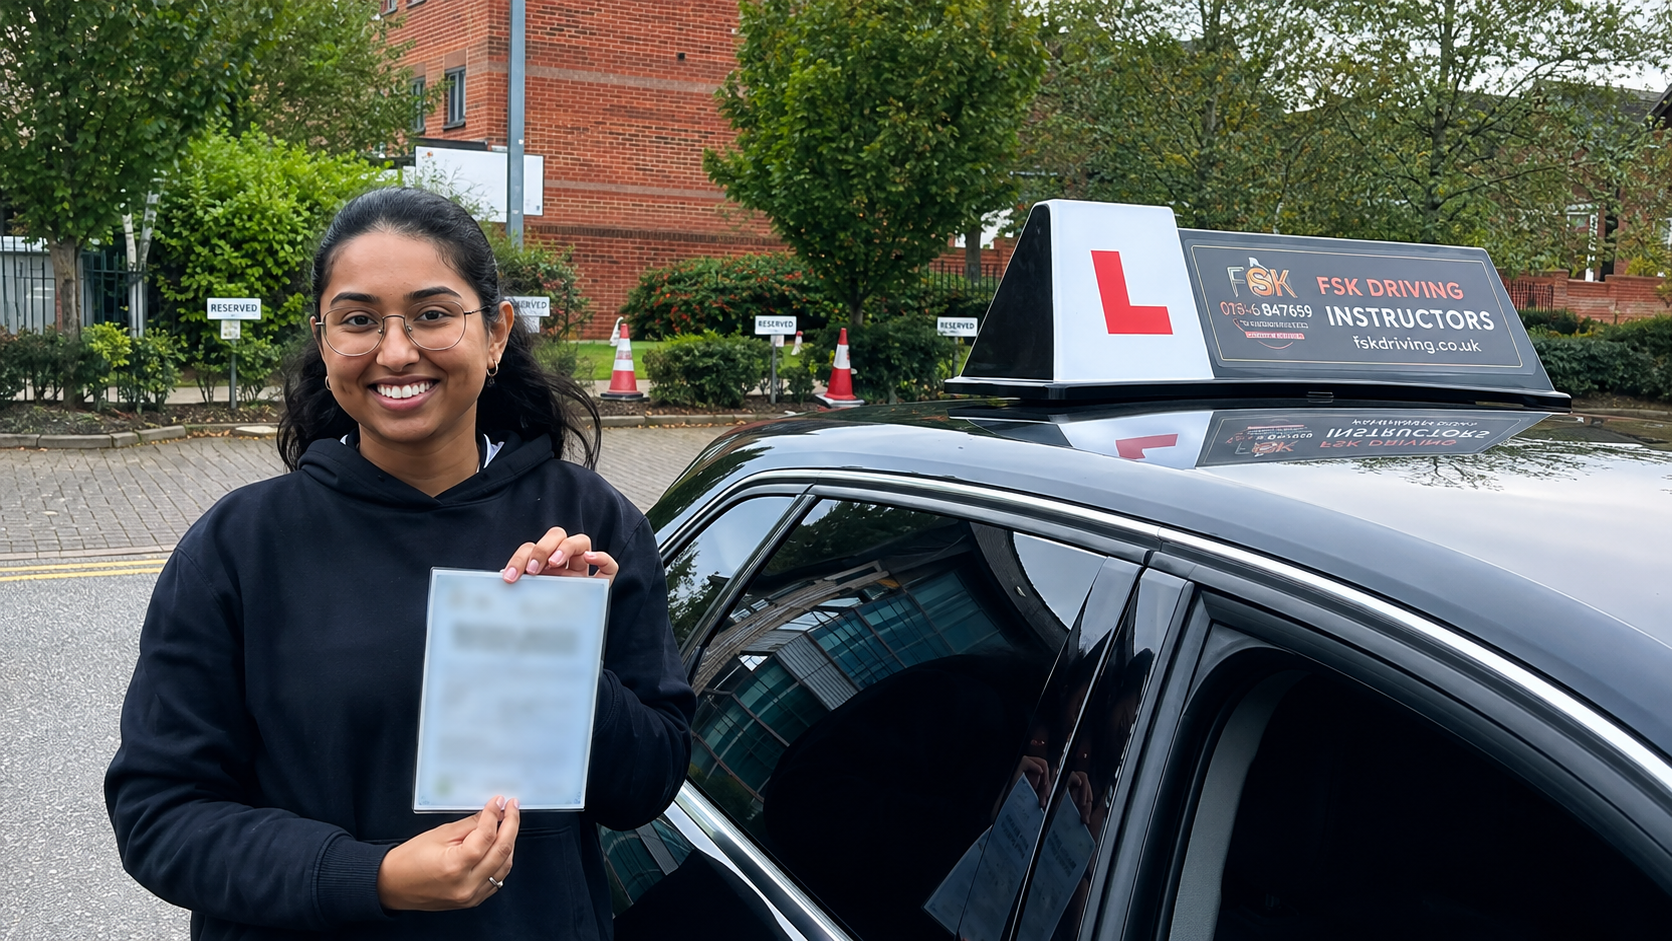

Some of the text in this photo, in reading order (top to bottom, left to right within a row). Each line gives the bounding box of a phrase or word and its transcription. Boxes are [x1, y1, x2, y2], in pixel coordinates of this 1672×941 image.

[1227, 265, 1298, 298] FSK
[1316, 276, 1464, 300] FSK DRIVING
[1090, 249, 1173, 334] L
[210, 303, 258, 313] RESERVED
[1261, 303, 1313, 318] 847659
[758, 320, 794, 328] RESERVED
[940, 321, 975, 330] RESERVED
[1325, 305, 1495, 331] INSTRUCTORS
[1353, 335, 1482, 354] fskdriving.co.uk
